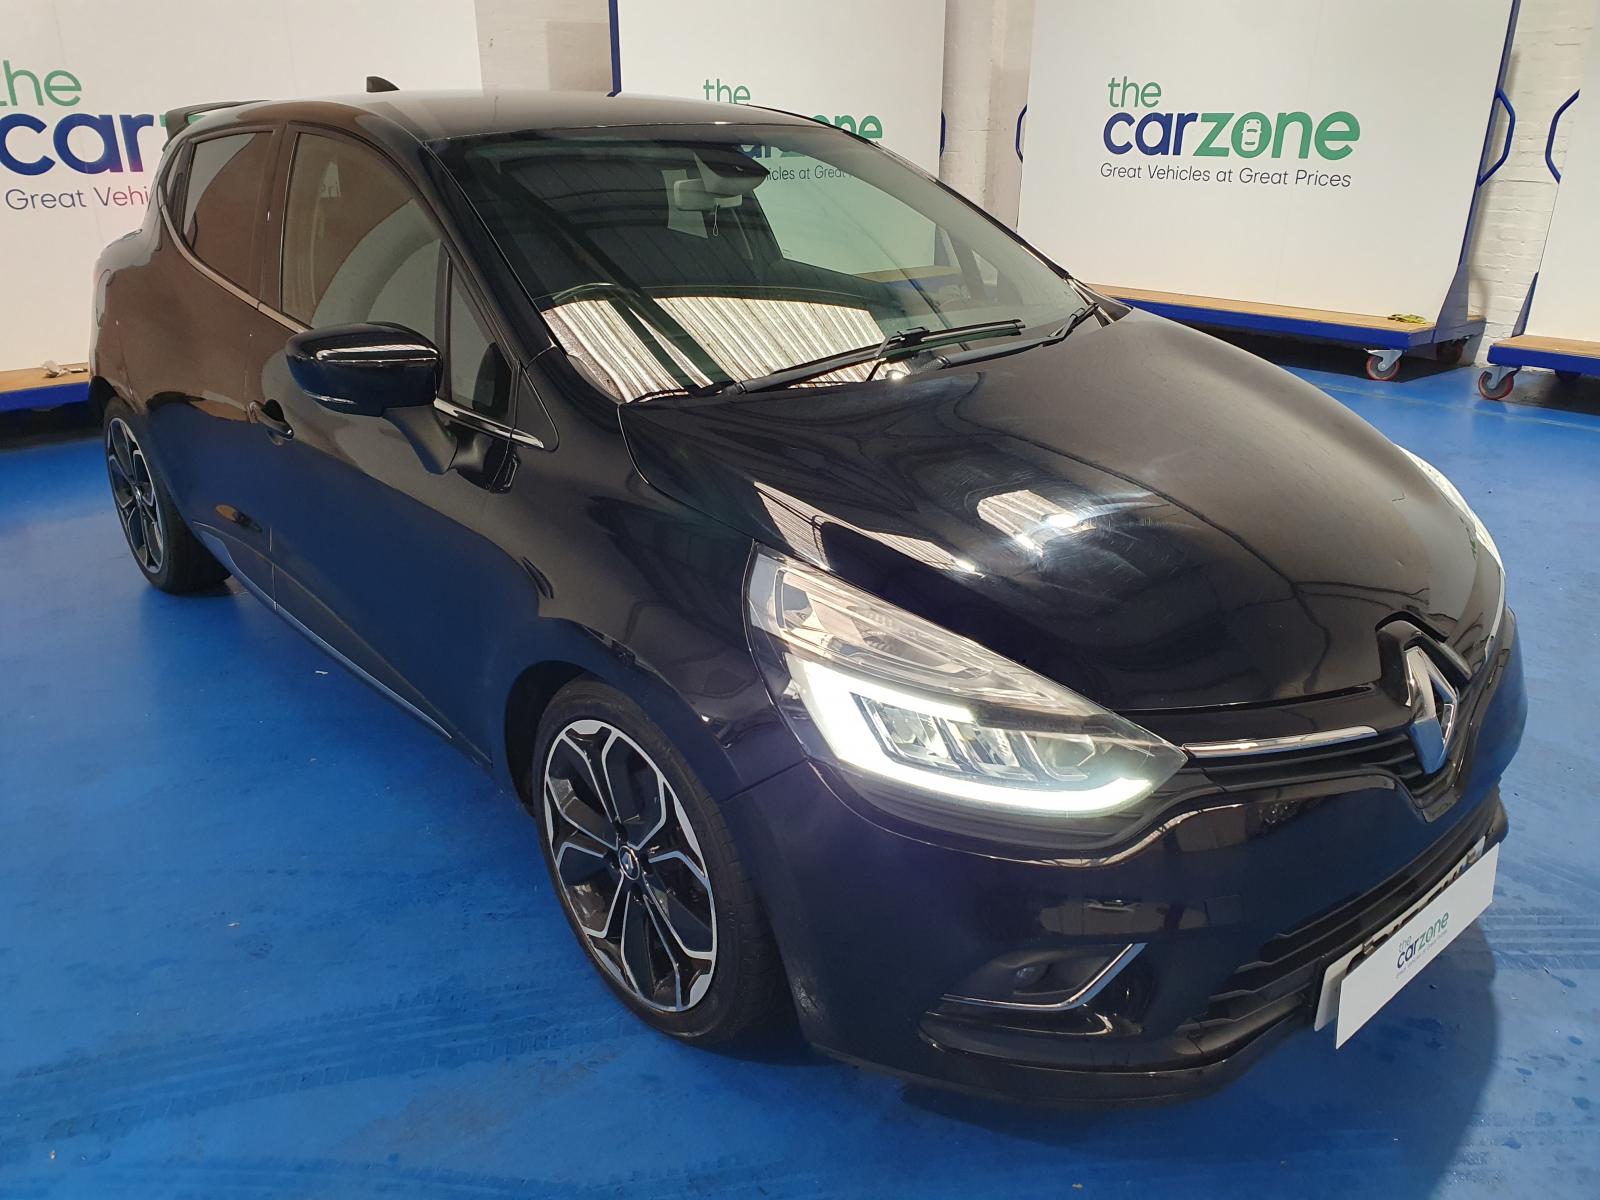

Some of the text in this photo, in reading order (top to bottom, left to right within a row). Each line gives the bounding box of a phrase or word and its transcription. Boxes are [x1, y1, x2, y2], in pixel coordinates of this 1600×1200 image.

[0, 60, 82, 107] he
[703, 78, 751, 104] the
[1108, 76, 1162, 108] the
[1103, 111, 1361, 161] carzone
[799, 168, 810, 180] at
[1100, 162, 1352, 188] Great Vehicles at Great Prices
[6, 185, 149, 210] Great Vehi
[1397, 911, 1450, 969] carzone
